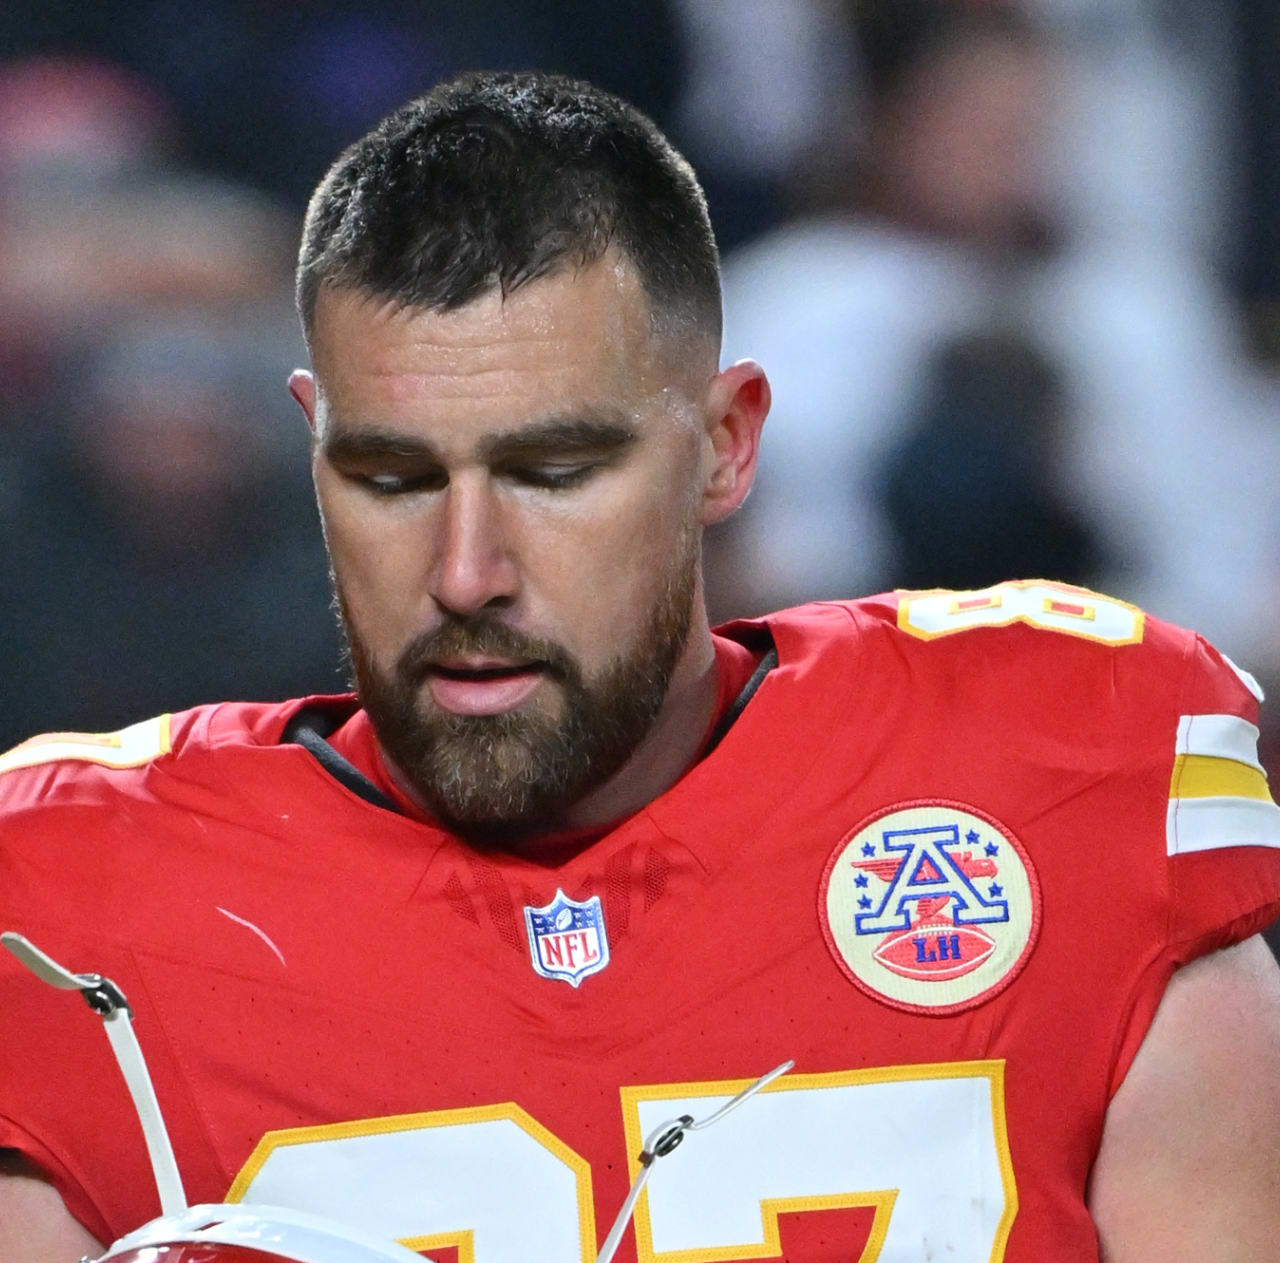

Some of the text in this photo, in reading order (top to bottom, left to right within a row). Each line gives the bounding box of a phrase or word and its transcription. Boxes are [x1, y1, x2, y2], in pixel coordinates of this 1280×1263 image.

[895, 579, 1145, 647] 8
[855, 824, 1009, 935] A
[541, 932, 598, 969] NFL
[912, 935, 961, 963] LH
